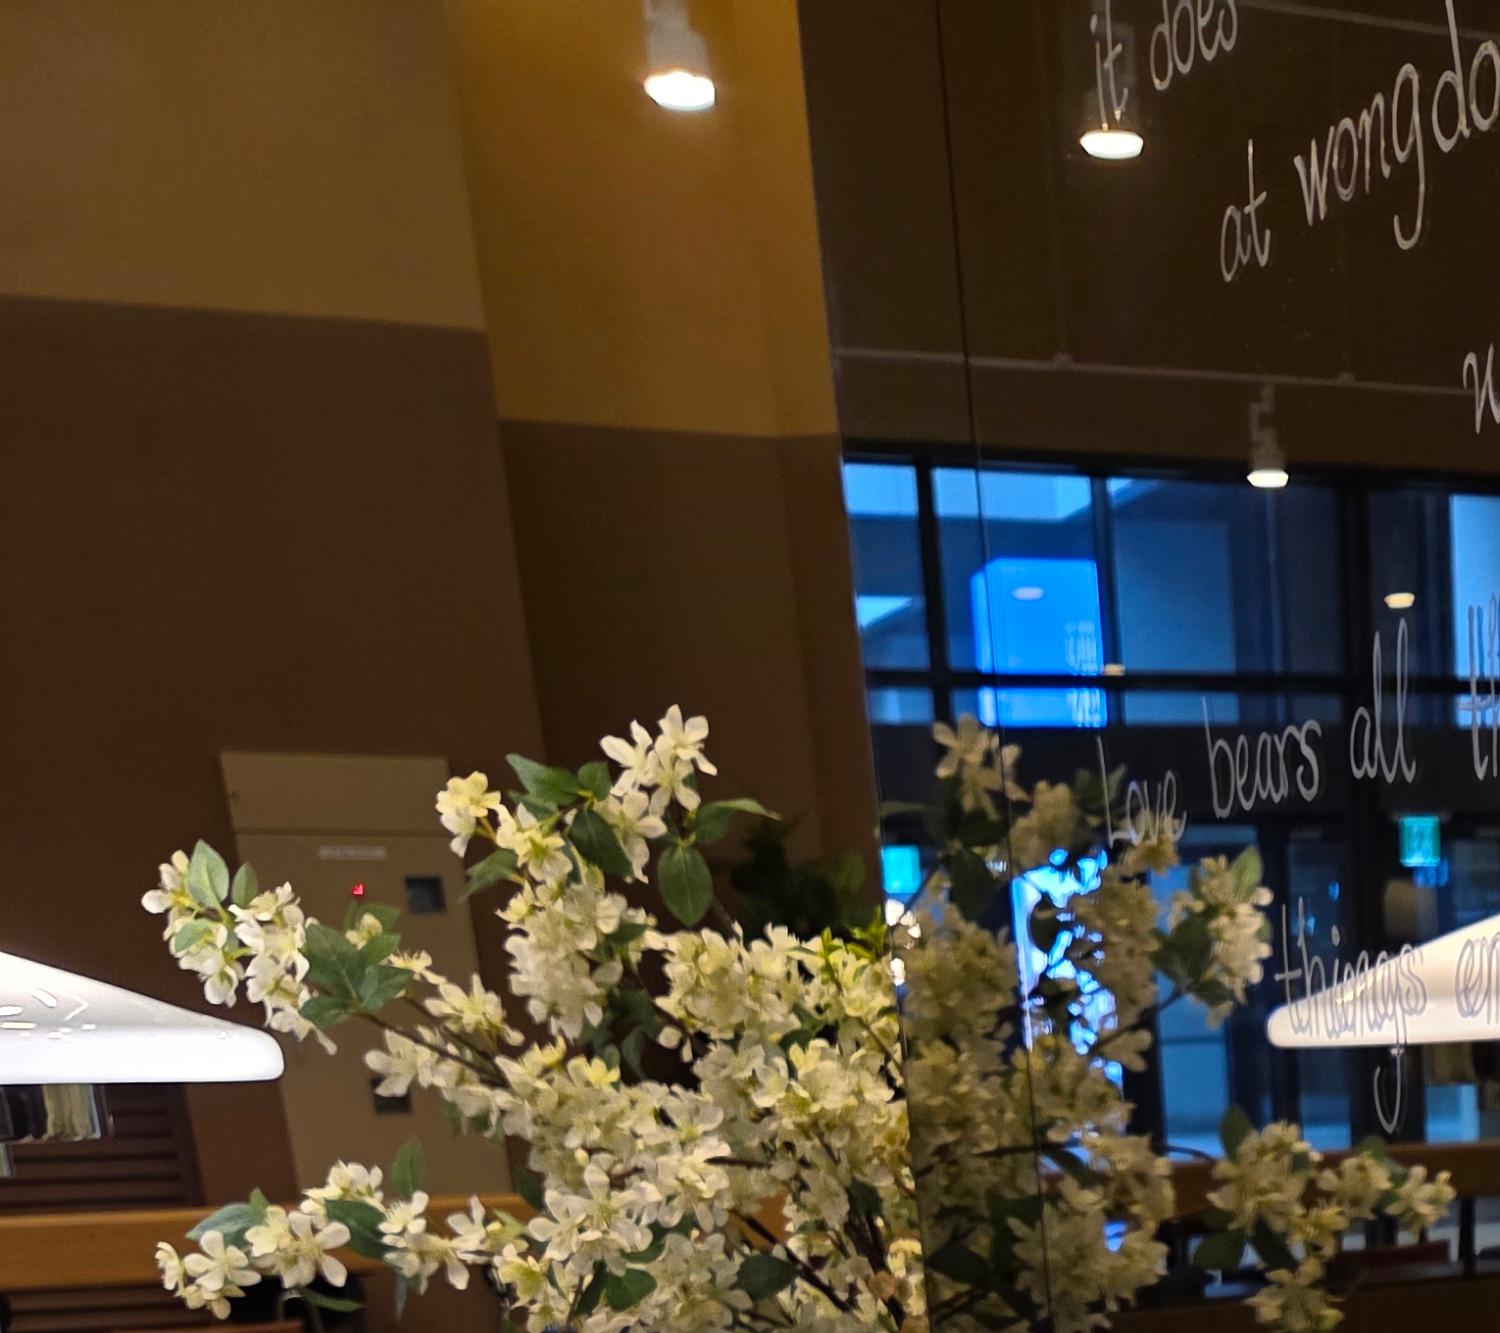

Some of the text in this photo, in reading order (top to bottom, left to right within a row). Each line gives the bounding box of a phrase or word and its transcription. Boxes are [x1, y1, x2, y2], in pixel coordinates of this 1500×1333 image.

[1089, 0, 1128, 131] it
[1219, 139, 1273, 284] at
[1201, 695, 1324, 820] bears
[1349, 617, 1418, 785] all
[1273, 895, 1429, 1135] things
